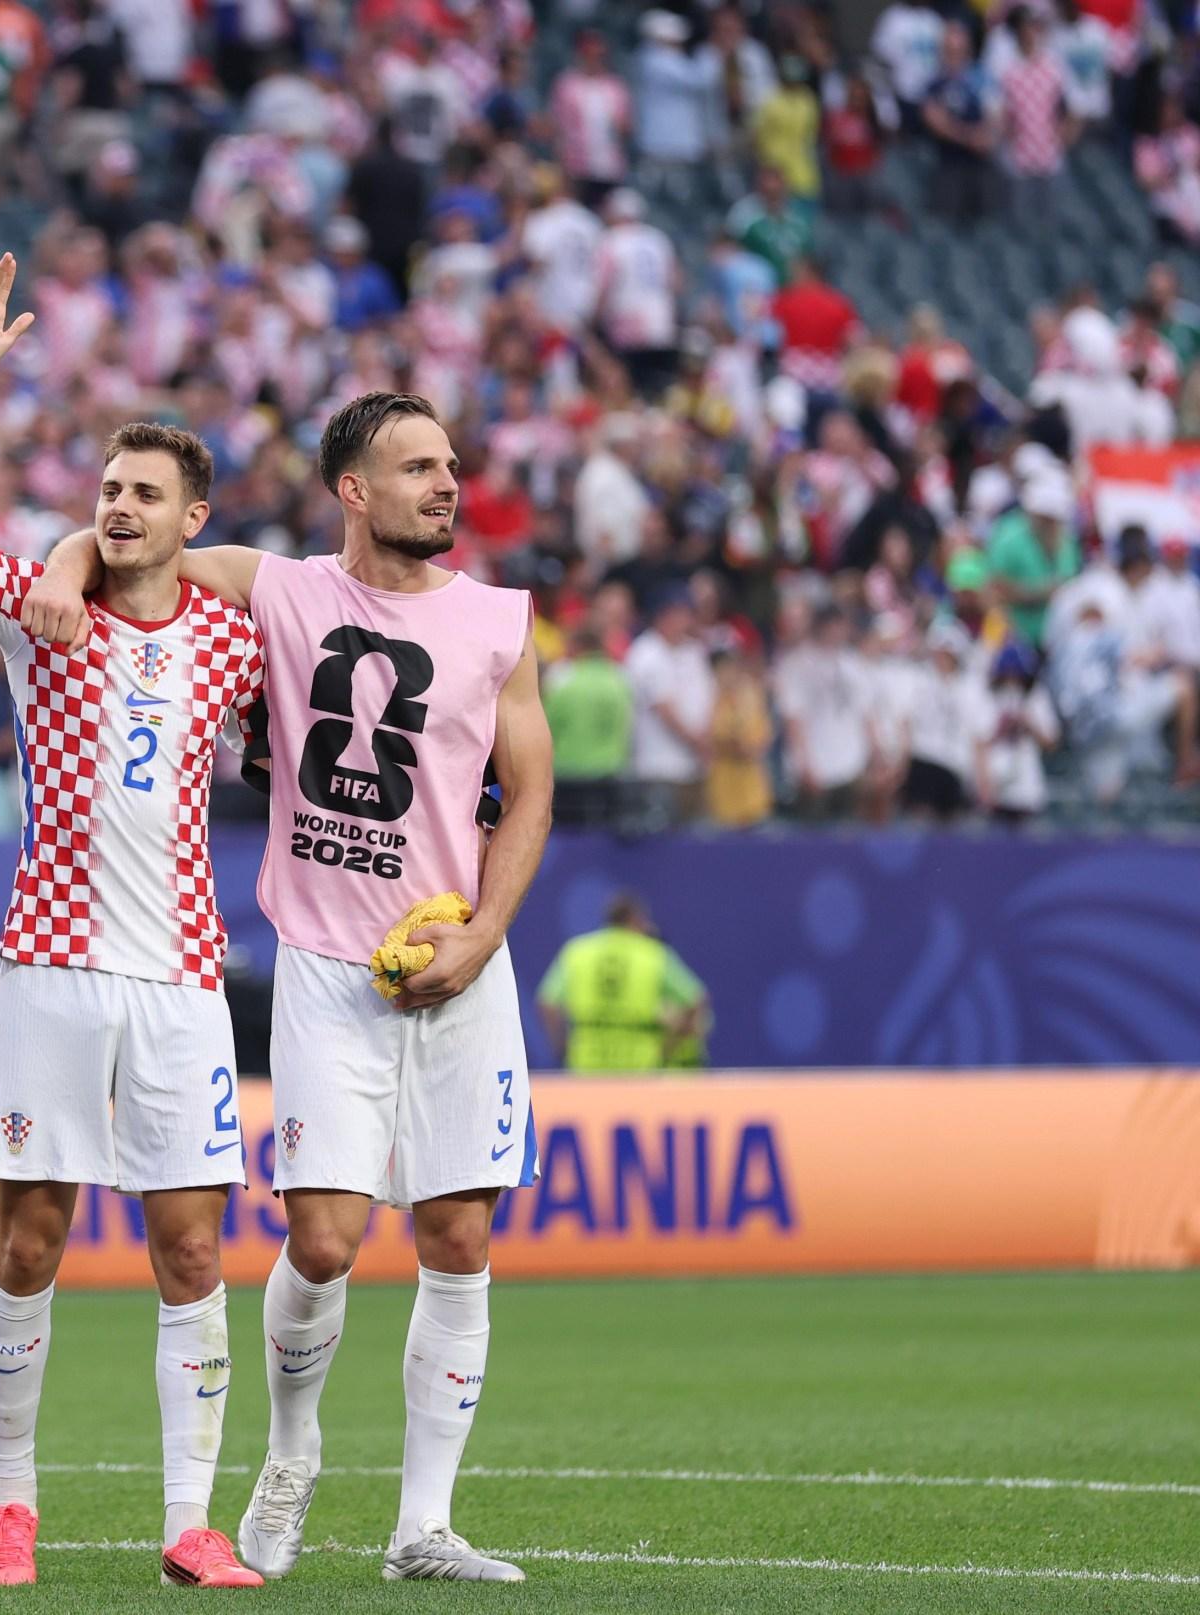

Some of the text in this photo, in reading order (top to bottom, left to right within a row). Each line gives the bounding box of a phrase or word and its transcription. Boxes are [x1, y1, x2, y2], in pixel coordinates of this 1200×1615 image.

[122, 726, 158, 793] 2
[329, 774, 381, 804] FIFA
[293, 810, 408, 850] WORLD CUP
[291, 832, 403, 880] 2026
[211, 1065, 238, 1132] 2
[497, 1069, 513, 1136] 3
[284, 1343, 323, 1358] HNS
[466, 1375, 484, 1385] HN
